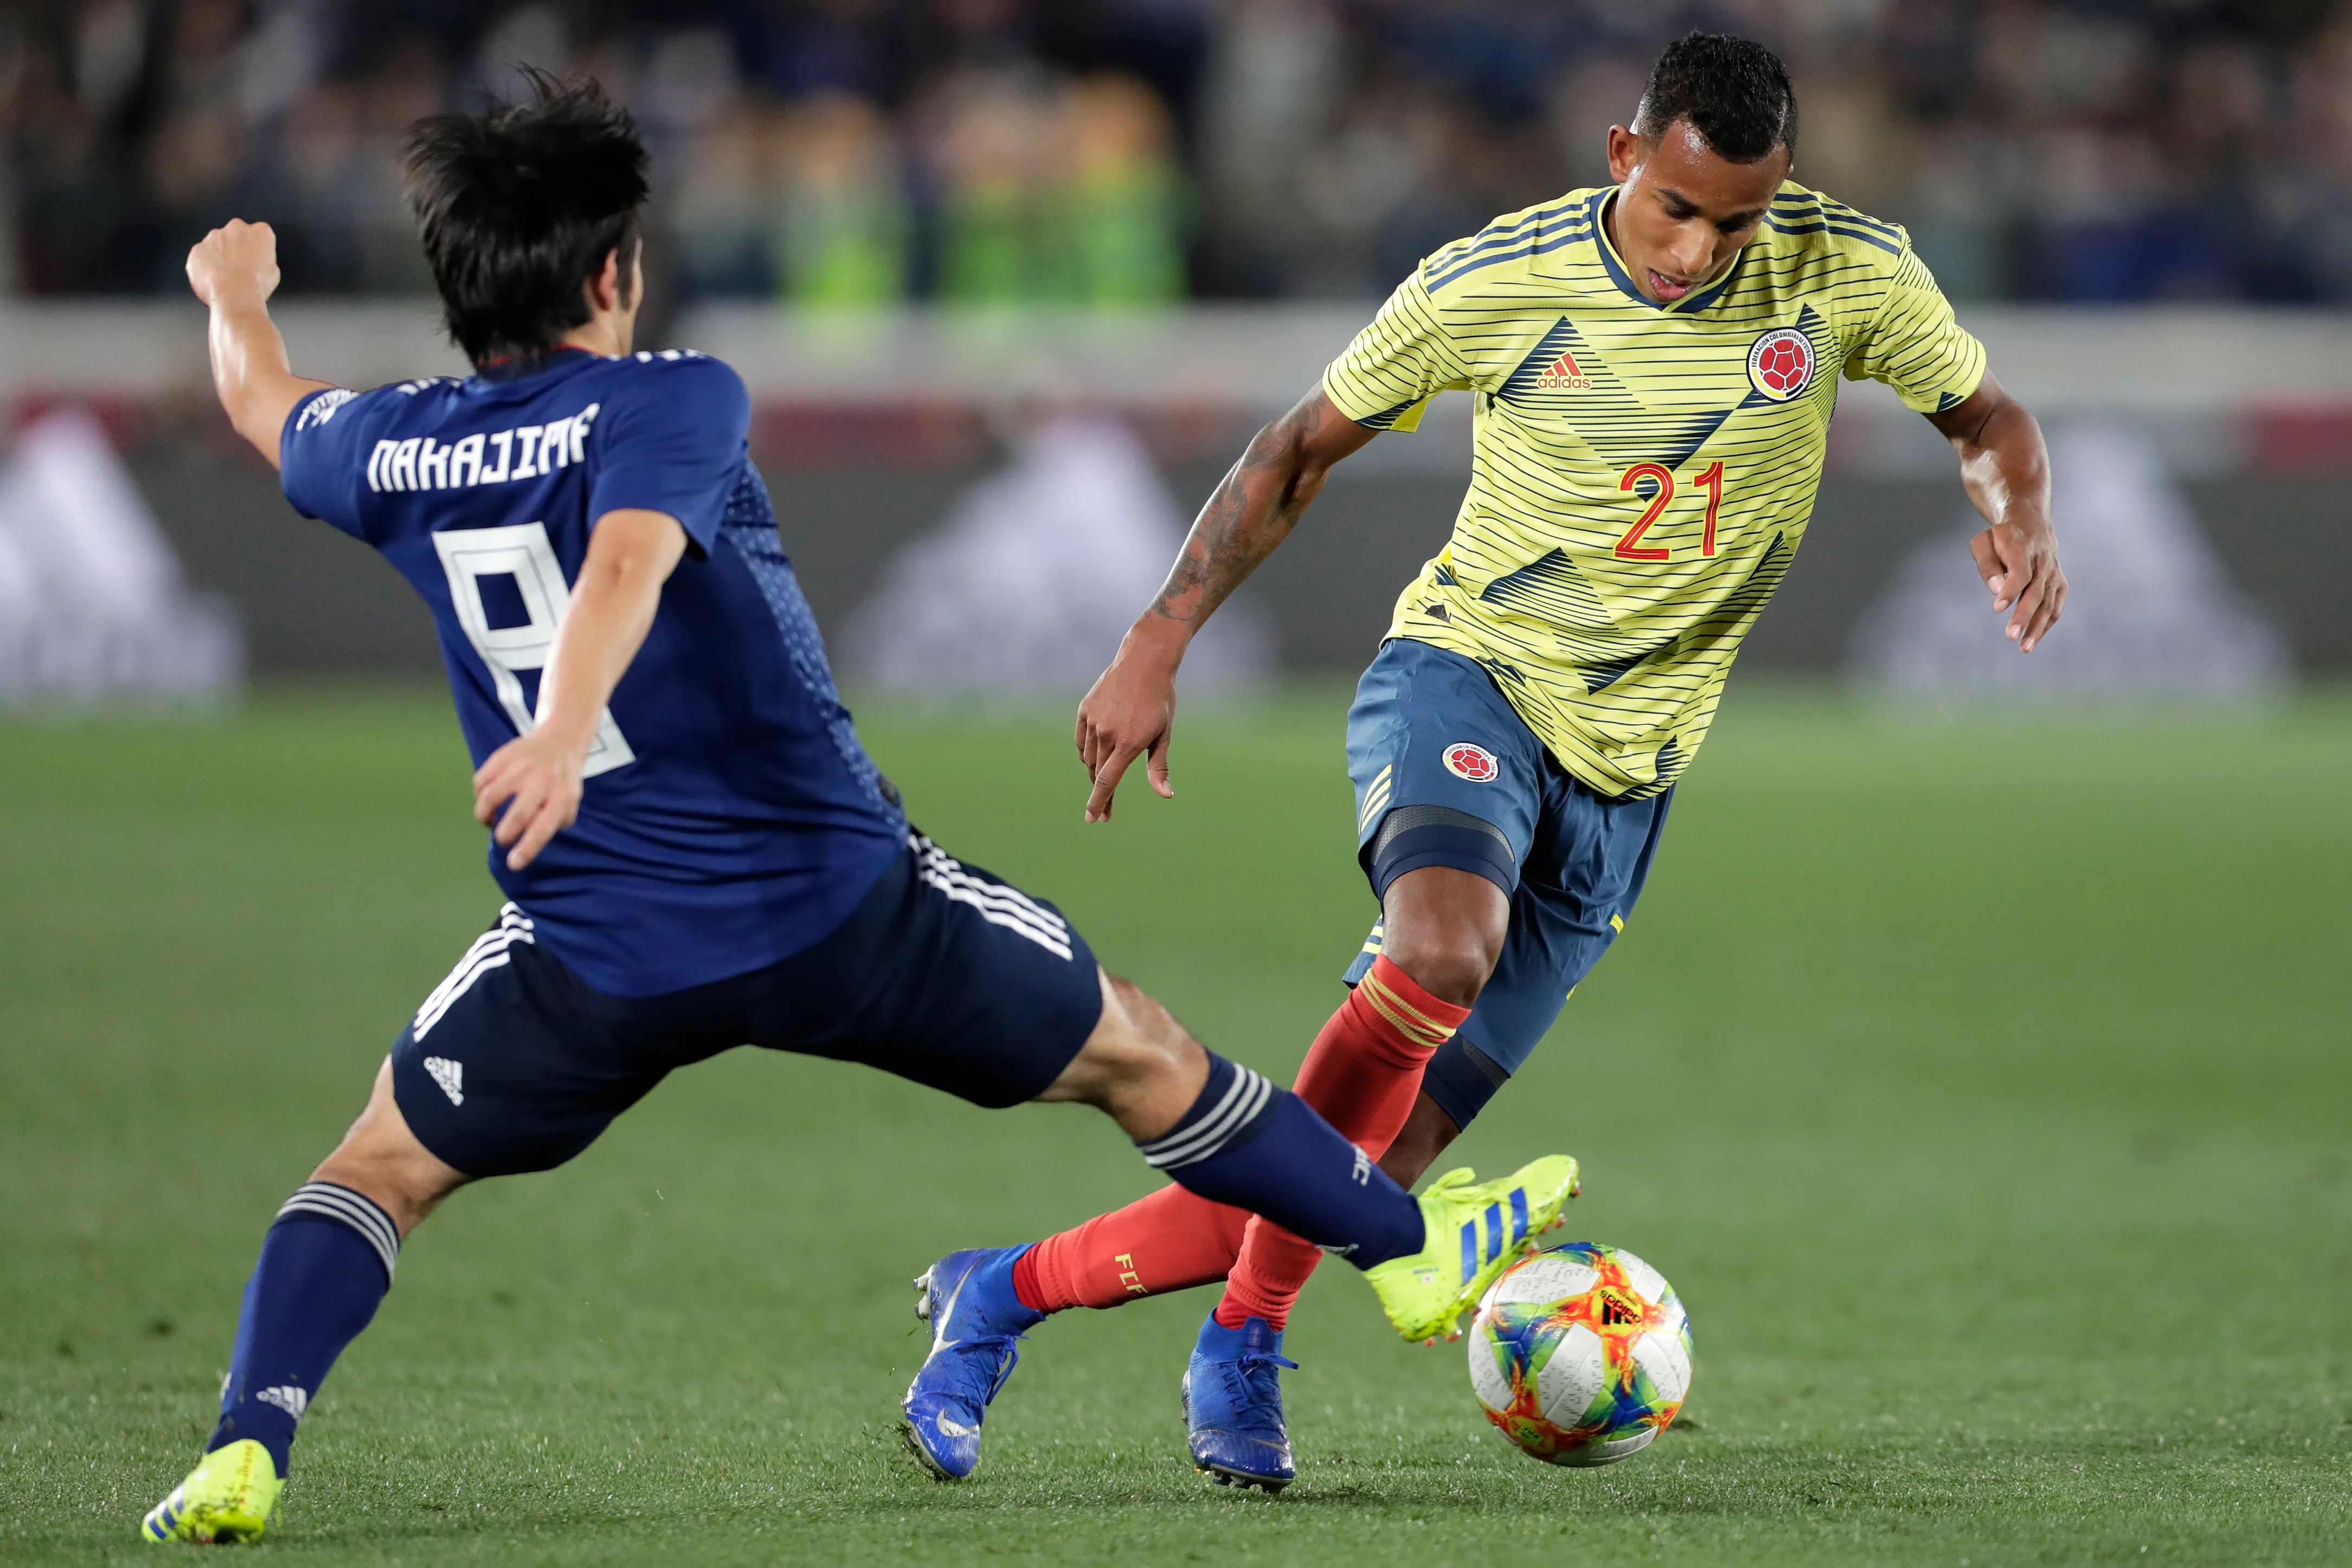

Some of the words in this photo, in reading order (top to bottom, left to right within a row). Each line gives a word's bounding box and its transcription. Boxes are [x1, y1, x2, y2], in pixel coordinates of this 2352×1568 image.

[1751, 337, 1770, 368] FEDERACION
[1769, 331, 1799, 340] COLOMBIANA
[1802, 343, 1812, 361] FUTBOL
[1538, 375, 1591, 389] adidas
[1614, 460, 1726, 561] 21
[1114, 1252, 1149, 1294] FCF
[1600, 1289, 1641, 1323] adidas
